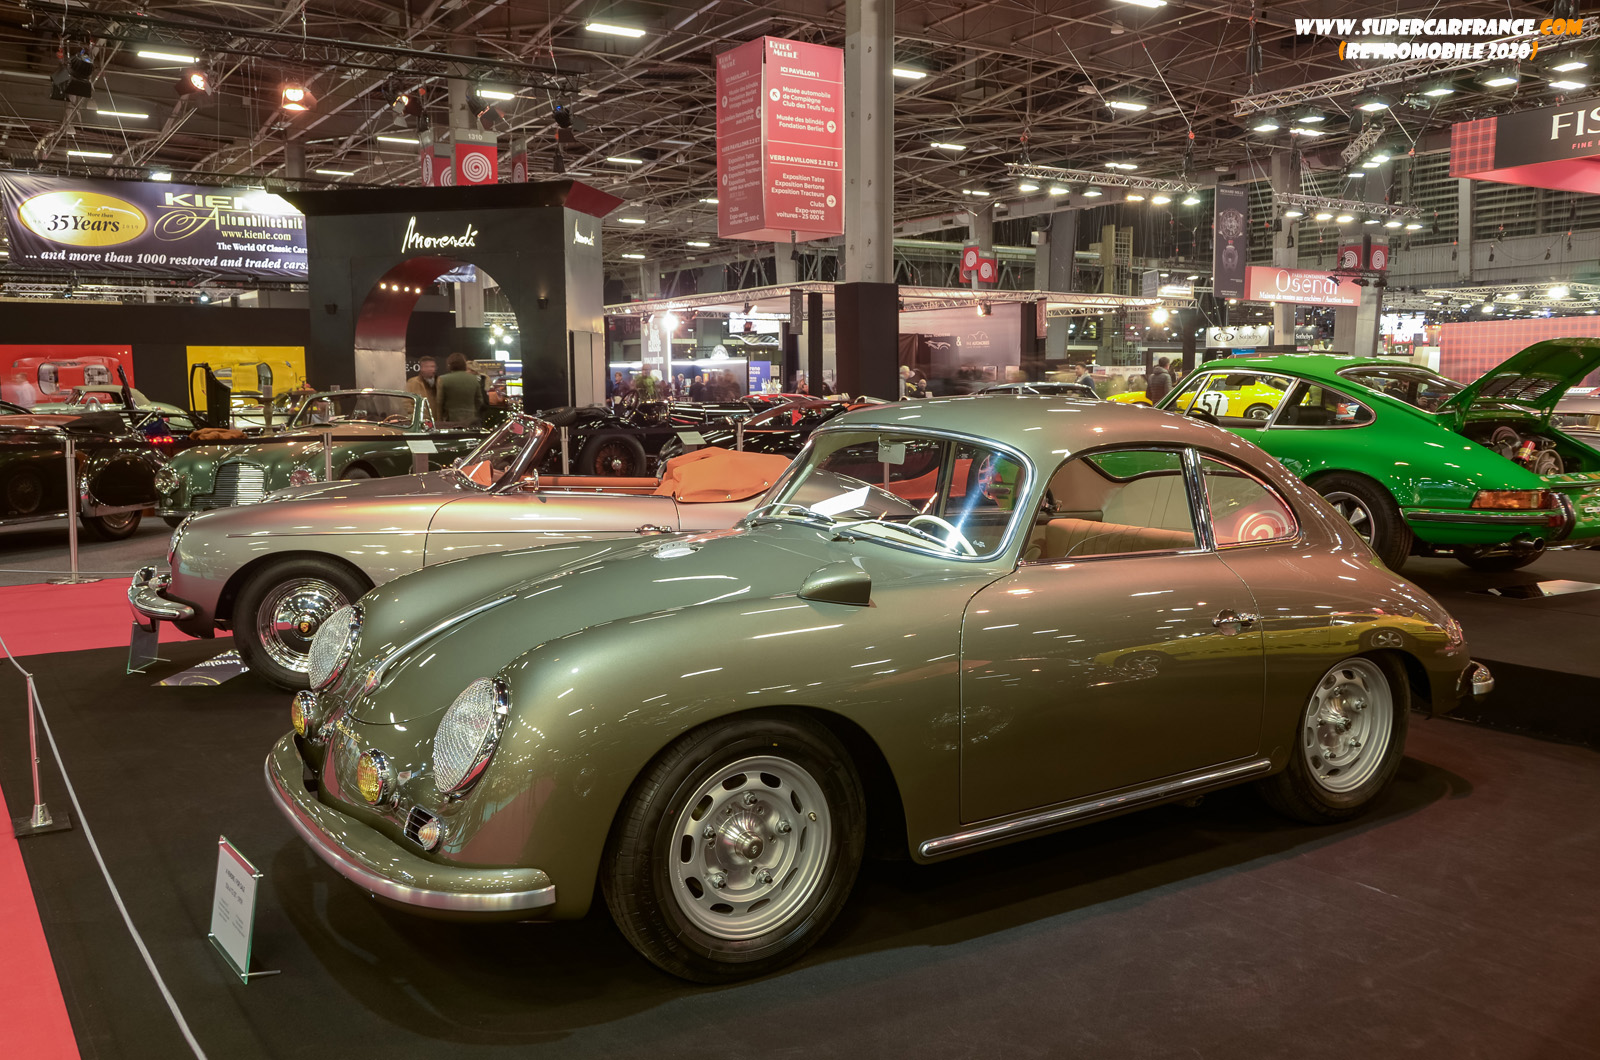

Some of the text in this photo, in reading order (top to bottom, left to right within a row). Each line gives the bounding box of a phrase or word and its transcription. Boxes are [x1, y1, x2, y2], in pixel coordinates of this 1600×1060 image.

[789, 67, 815, 76] PAVILLON
[783, 86, 831, 98] Musée automobile
[791, 95, 821, 104] Compiègne
[779, 121, 806, 130] Fondation
[1572, 141, 1592, 149] FINE
[786, 156, 817, 164] PAVILLONS
[783, 173, 810, 181] Exposition
[775, 180, 803, 188] Exposition
[771, 187, 799, 195] Exposition
[48, 214, 69, 231] 35
[72, 215, 120, 232] Years
[221, 230, 291, 241] www.kienle.com
[216, 242, 231, 250] The
[233, 243, 255, 252] World
[256, 244, 266, 252] Of
[267, 244, 292, 253] Classic
[41, 250, 66, 260] and
[69, 253, 100, 262] more
[104, 252, 132, 263] than
[136, 254, 166, 264] 1000
[170, 256, 218, 267] restored
[220, 257, 242, 268] and
[245, 258, 281, 269] traded
[1259, 291, 1275, 299] Maison
[1276, 292, 1281, 300] de
[956, 336, 961, 346] &
[1202, 394, 1222, 416] 57
